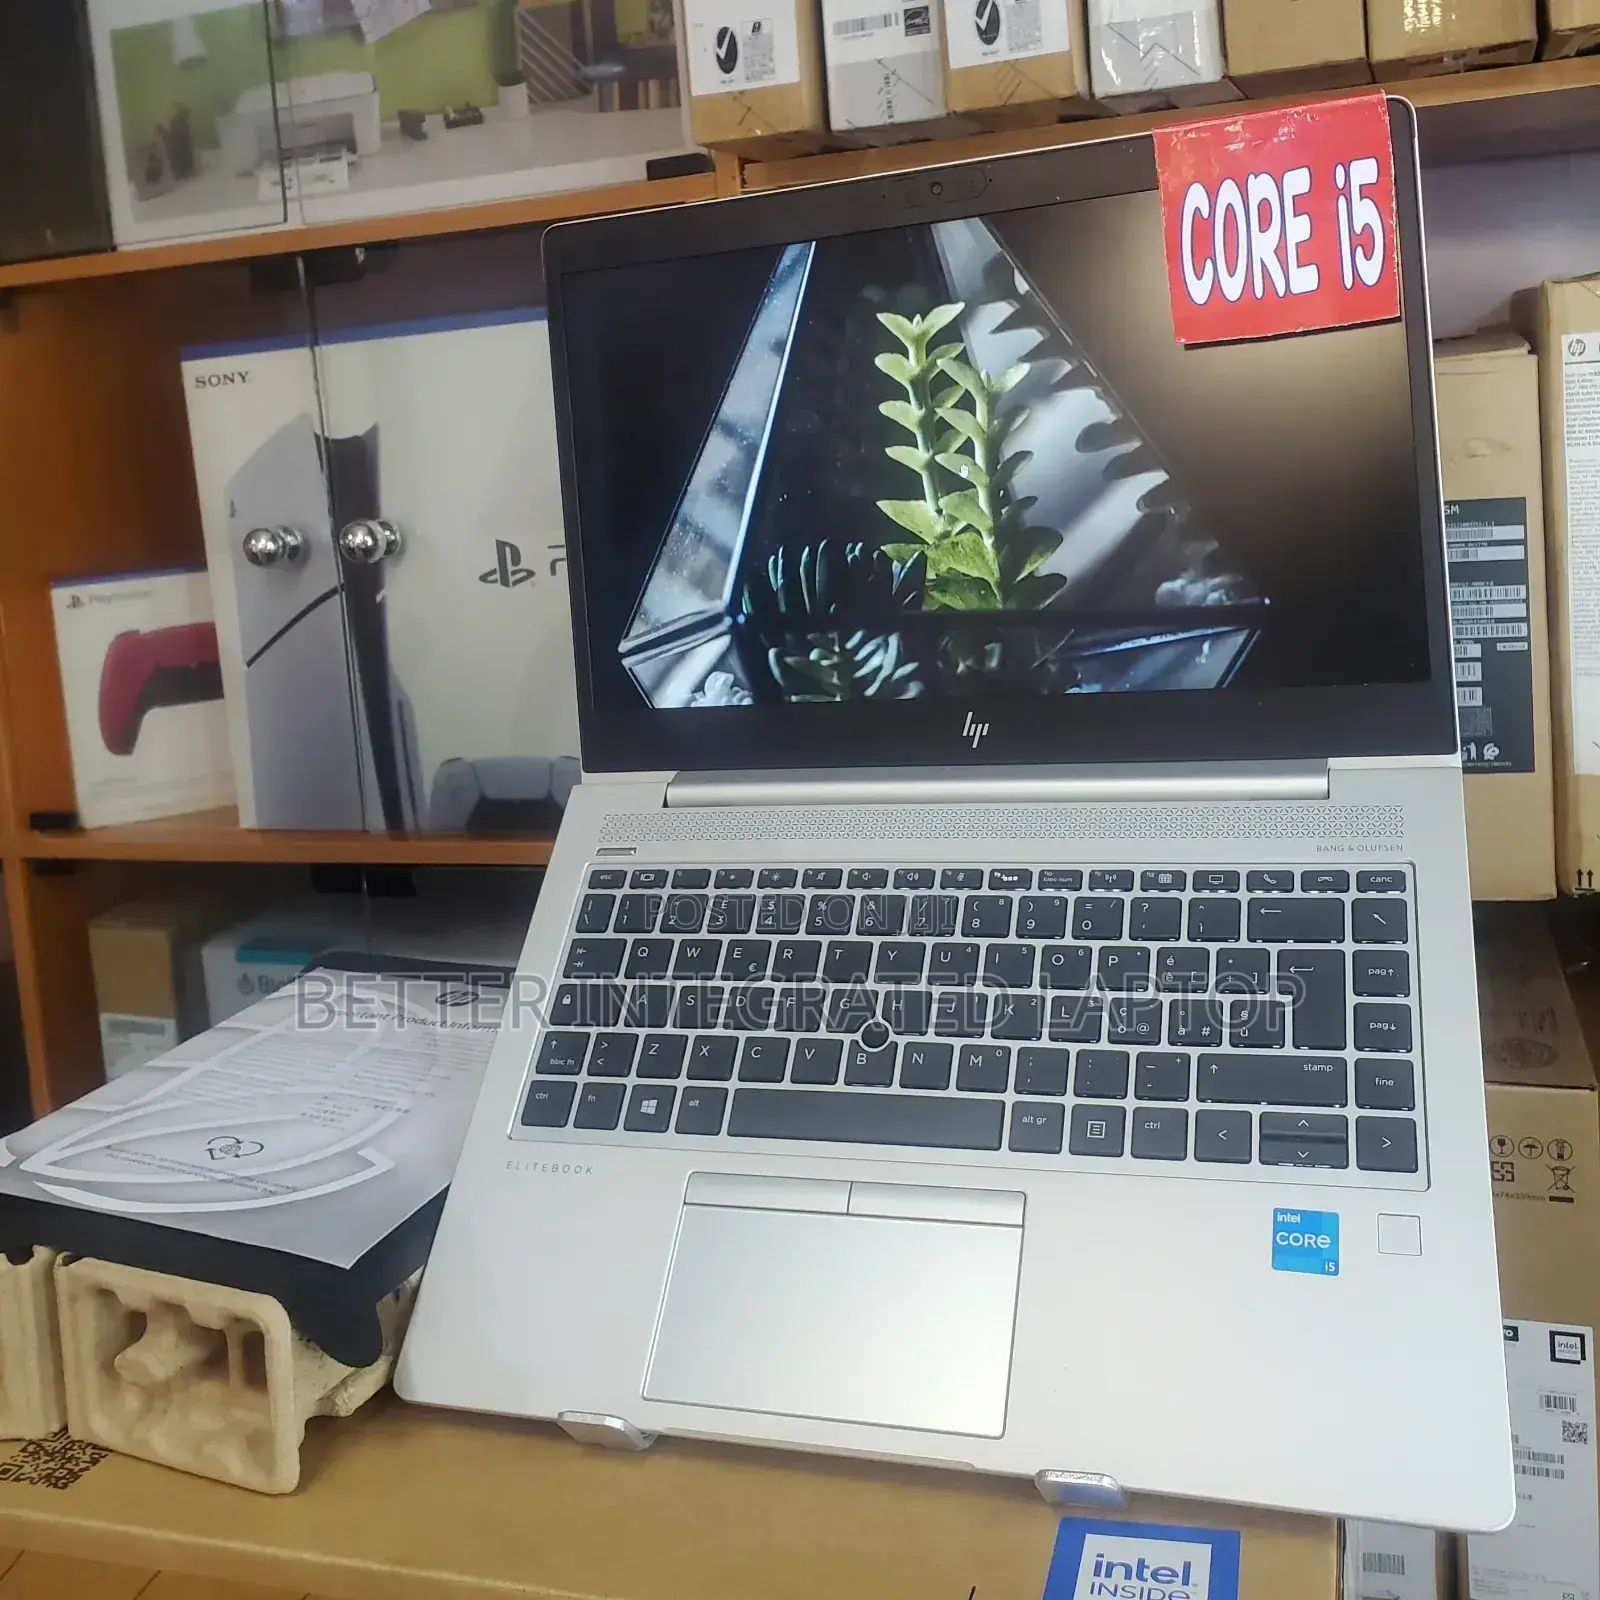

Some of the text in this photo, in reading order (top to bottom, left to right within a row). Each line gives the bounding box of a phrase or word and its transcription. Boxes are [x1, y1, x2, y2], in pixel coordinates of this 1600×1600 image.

[1181, 156, 1385, 306] CORE i5
[195, 371, 249, 389] SONY
[962, 711, 990, 749] hp
[1316, 844, 1403, 852] BANG & OLUFSEN
[1370, 875, 1393, 883] canc
[1141, 902, 1149, 913] ?
[668, 915, 677, 925] 2
[716, 915, 724, 925] 3
[764, 915, 773, 925] 4
[814, 916, 823, 926] 5
[865, 916, 874, 927] 6
[971, 918, 981, 928] 8
[1026, 918, 1035, 929] 9
[637, 946, 649, 958] Q
[686, 947, 701, 958] W
[733, 947, 743, 959] E
[782, 949, 794, 960] R
[834, 949, 844, 960] T
[887, 950, 898, 961] Y
[940, 951, 951, 963] U
[1108, 955, 1119, 967] P
[1166, 954, 1175, 966] é
[748, 962, 757, 972] €
[1368, 967, 1387, 976] pag
[637, 994, 647, 1005] A
[686, 994, 696, 1006] S
[735, 996, 747, 1007] D
[786, 997, 796, 1008] F
[839, 998, 851, 1009] G
[891, 999, 903, 1011] H
[947, 1001, 956, 1013] J
[1003, 1004, 1015, 1016] K
[1061, 1006, 1070, 1018] L
[1136, 1023, 1150, 1035] @
[1200, 1026, 1211, 1037] #
[1369, 1022, 1388, 1031] pag
[648, 1044, 660, 1055] Z
[699, 1045, 711, 1057] X
[751, 1046, 763, 1058] C
[804, 1048, 815, 1060] V
[856, 1053, 867, 1065] B
[911, 1053, 924, 1065] N
[969, 1055, 983, 1067] M
[1303, 1062, 1334, 1073] stamp
[1375, 1077, 1395, 1086] fine
[535, 1092, 549, 1100] ctrl
[587, 1093, 596, 1102] fn
[689, 1099, 701, 1107] alt
[1021, 1114, 1047, 1125] alt gr
[1144, 1121, 1161, 1130] ctrl
[506, 1160, 594, 1175] ELITEBOOK
[1276, 1211, 1301, 1224] intel
[1324, 1261, 1336, 1272] i5
[1557, 1339, 1579, 1350] intel
[1092, 1552, 1192, 1587] intel
